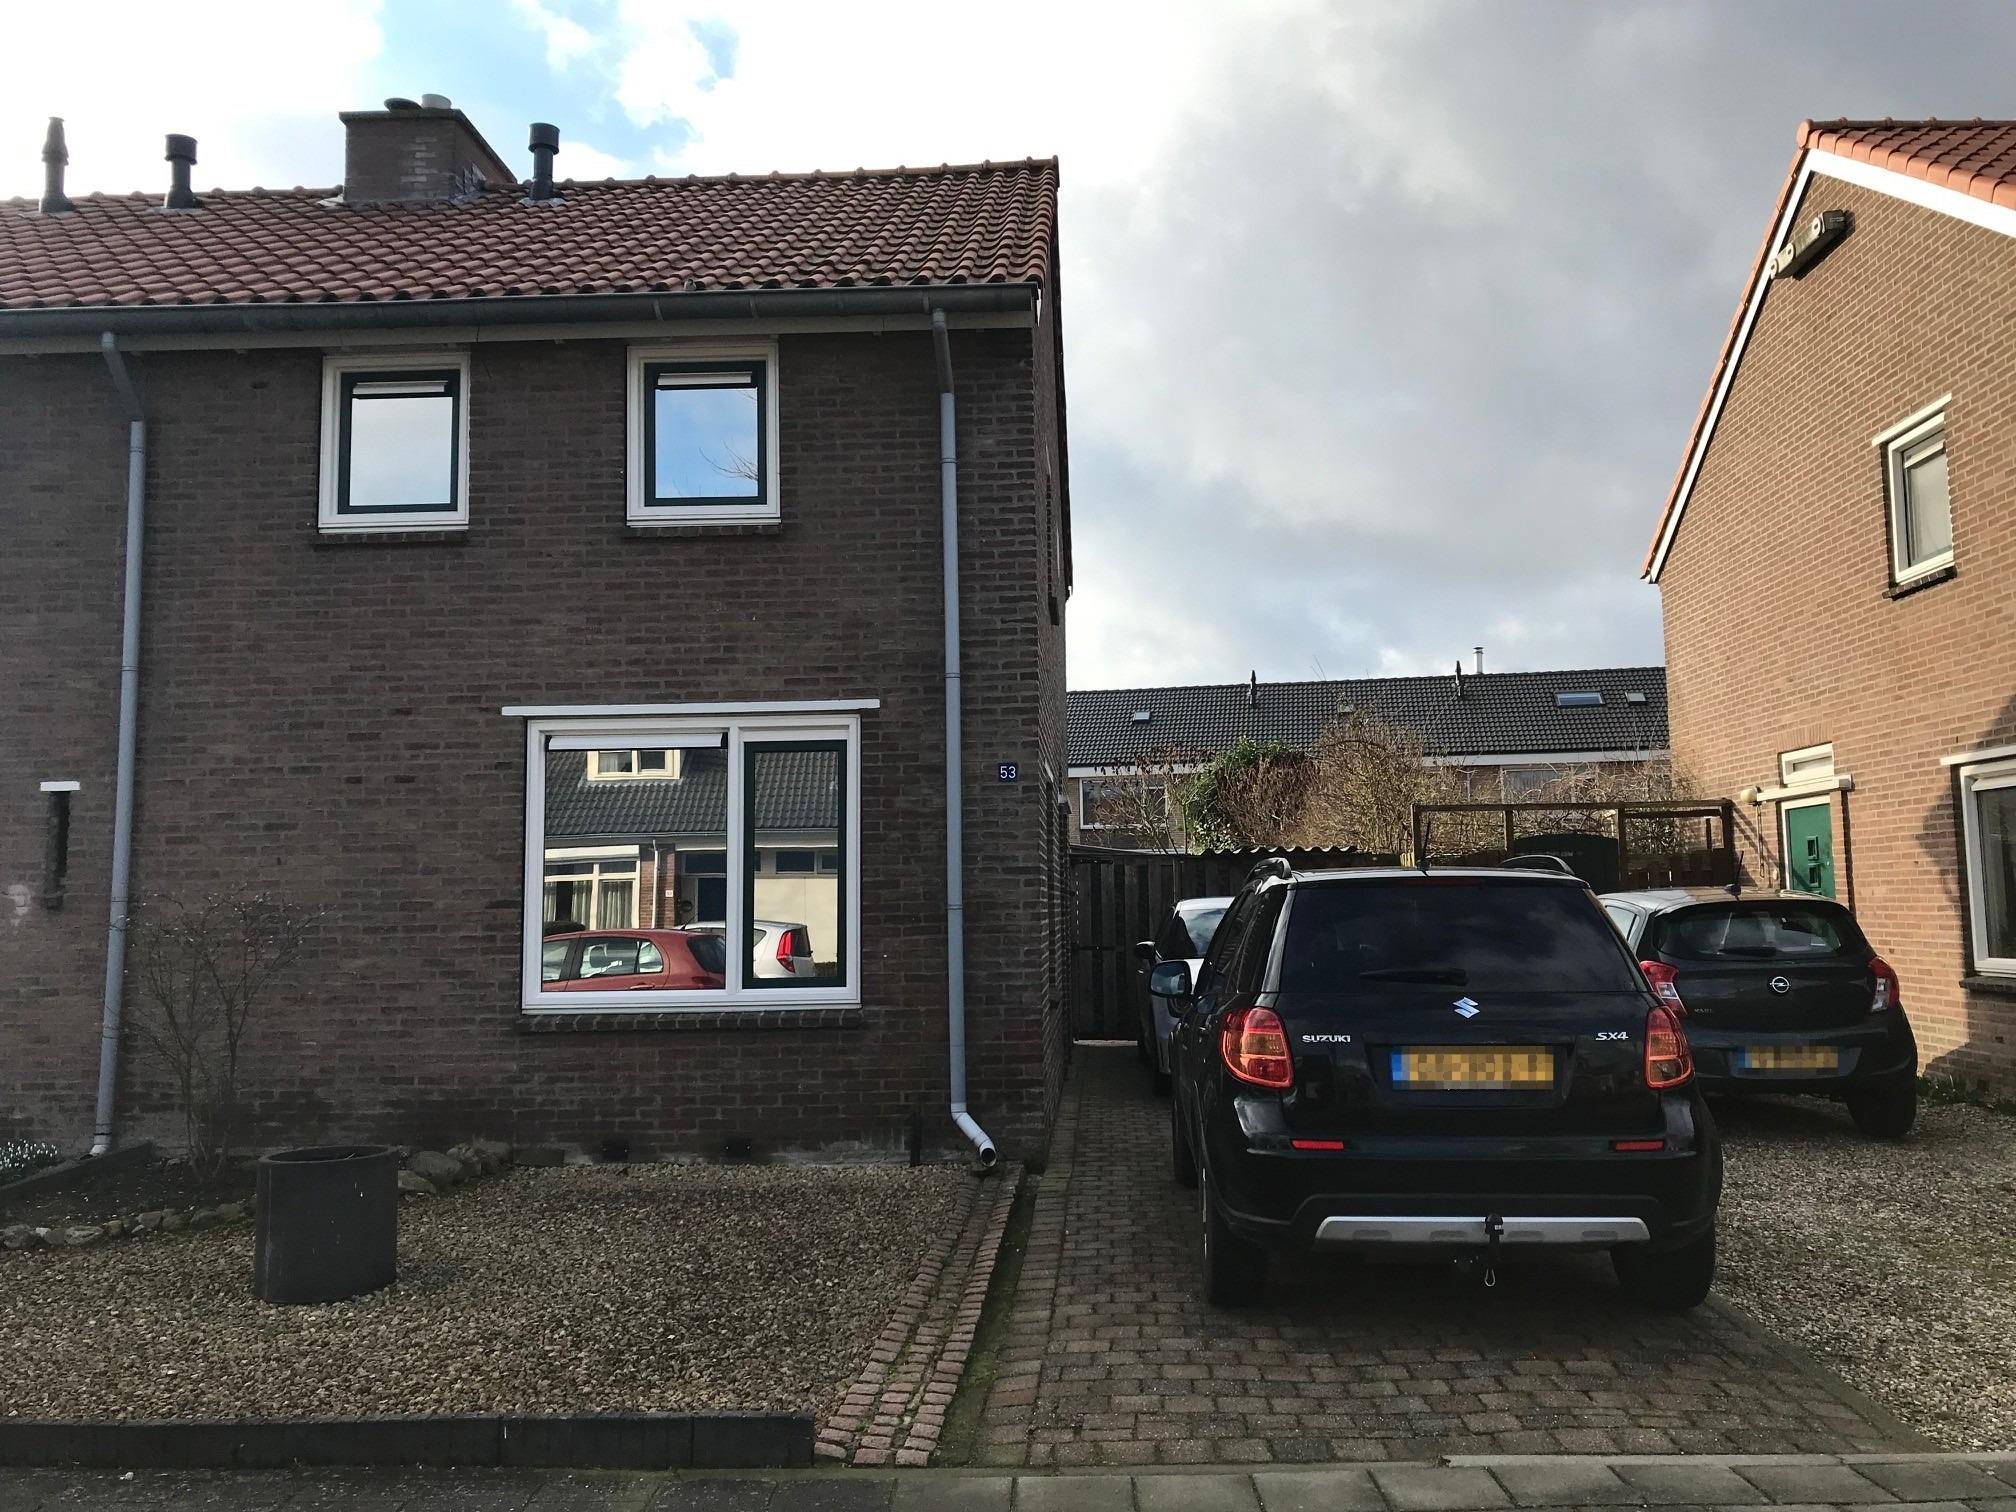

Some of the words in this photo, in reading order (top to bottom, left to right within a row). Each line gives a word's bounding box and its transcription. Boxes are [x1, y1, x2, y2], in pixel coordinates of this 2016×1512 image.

[1000, 765, 1016, 779] 53
[1302, 1034, 1351, 1043] SUZUKI
[1595, 1031, 1630, 1041] SX4
